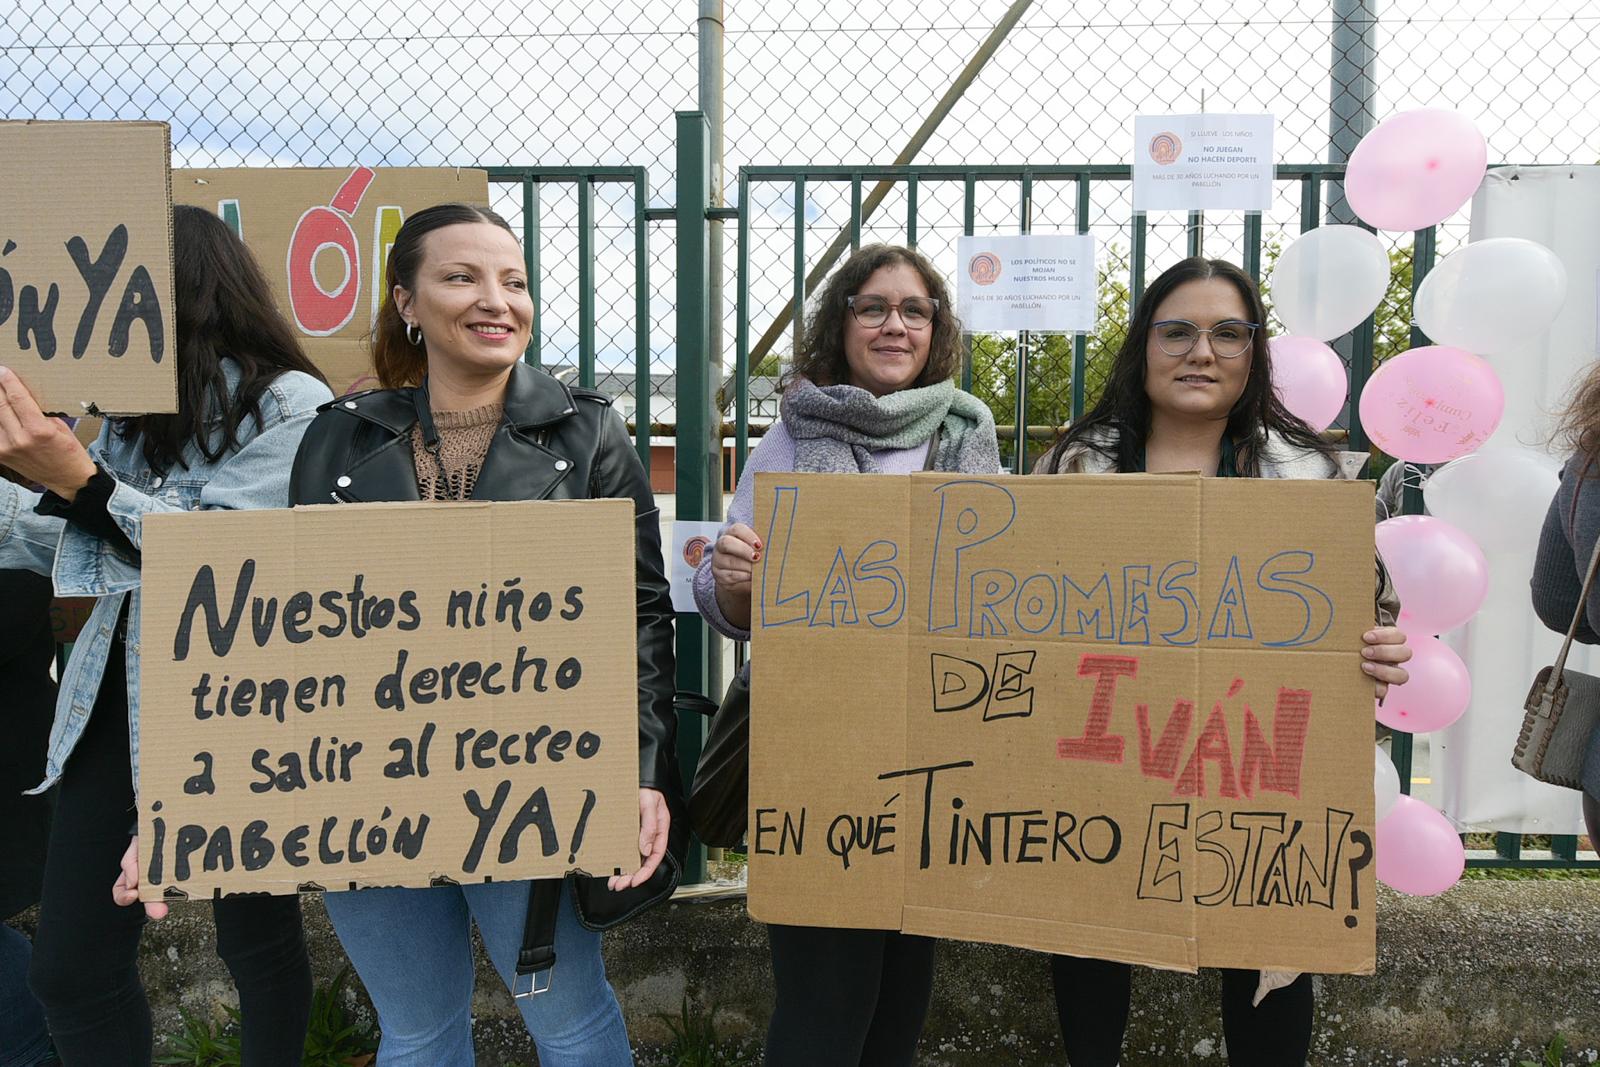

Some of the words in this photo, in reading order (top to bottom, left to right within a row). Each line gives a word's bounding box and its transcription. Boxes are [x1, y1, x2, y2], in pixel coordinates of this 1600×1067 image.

[1184, 171, 1202, 179] AÑOS
[65, 223, 165, 364] YA
[1004, 293, 1022, 301] AÑOS
[1024, 257, 1056, 265] POLÍTICOS
[173, 558, 421, 662] Nuestros
[446, 577, 584, 633] niños
[761, 486, 907, 628] LAS
[928, 479, 1334, 647] PROMESAS
[192, 673, 346, 722] tienen
[375, 646, 582, 711] derecho
[930, 650, 1037, 723] DE
[1056, 652, 1314, 801] IVÁN
[184, 751, 216, 795] a
[250, 736, 363, 794] salir
[384, 722, 437, 779] al
[456, 726, 601, 770] recreo
[462, 779, 597, 874] YA!
[752, 807, 806, 856] EN
[827, 793, 897, 871] QUÉ
[1137, 802, 1374, 929] ESTÁN?
